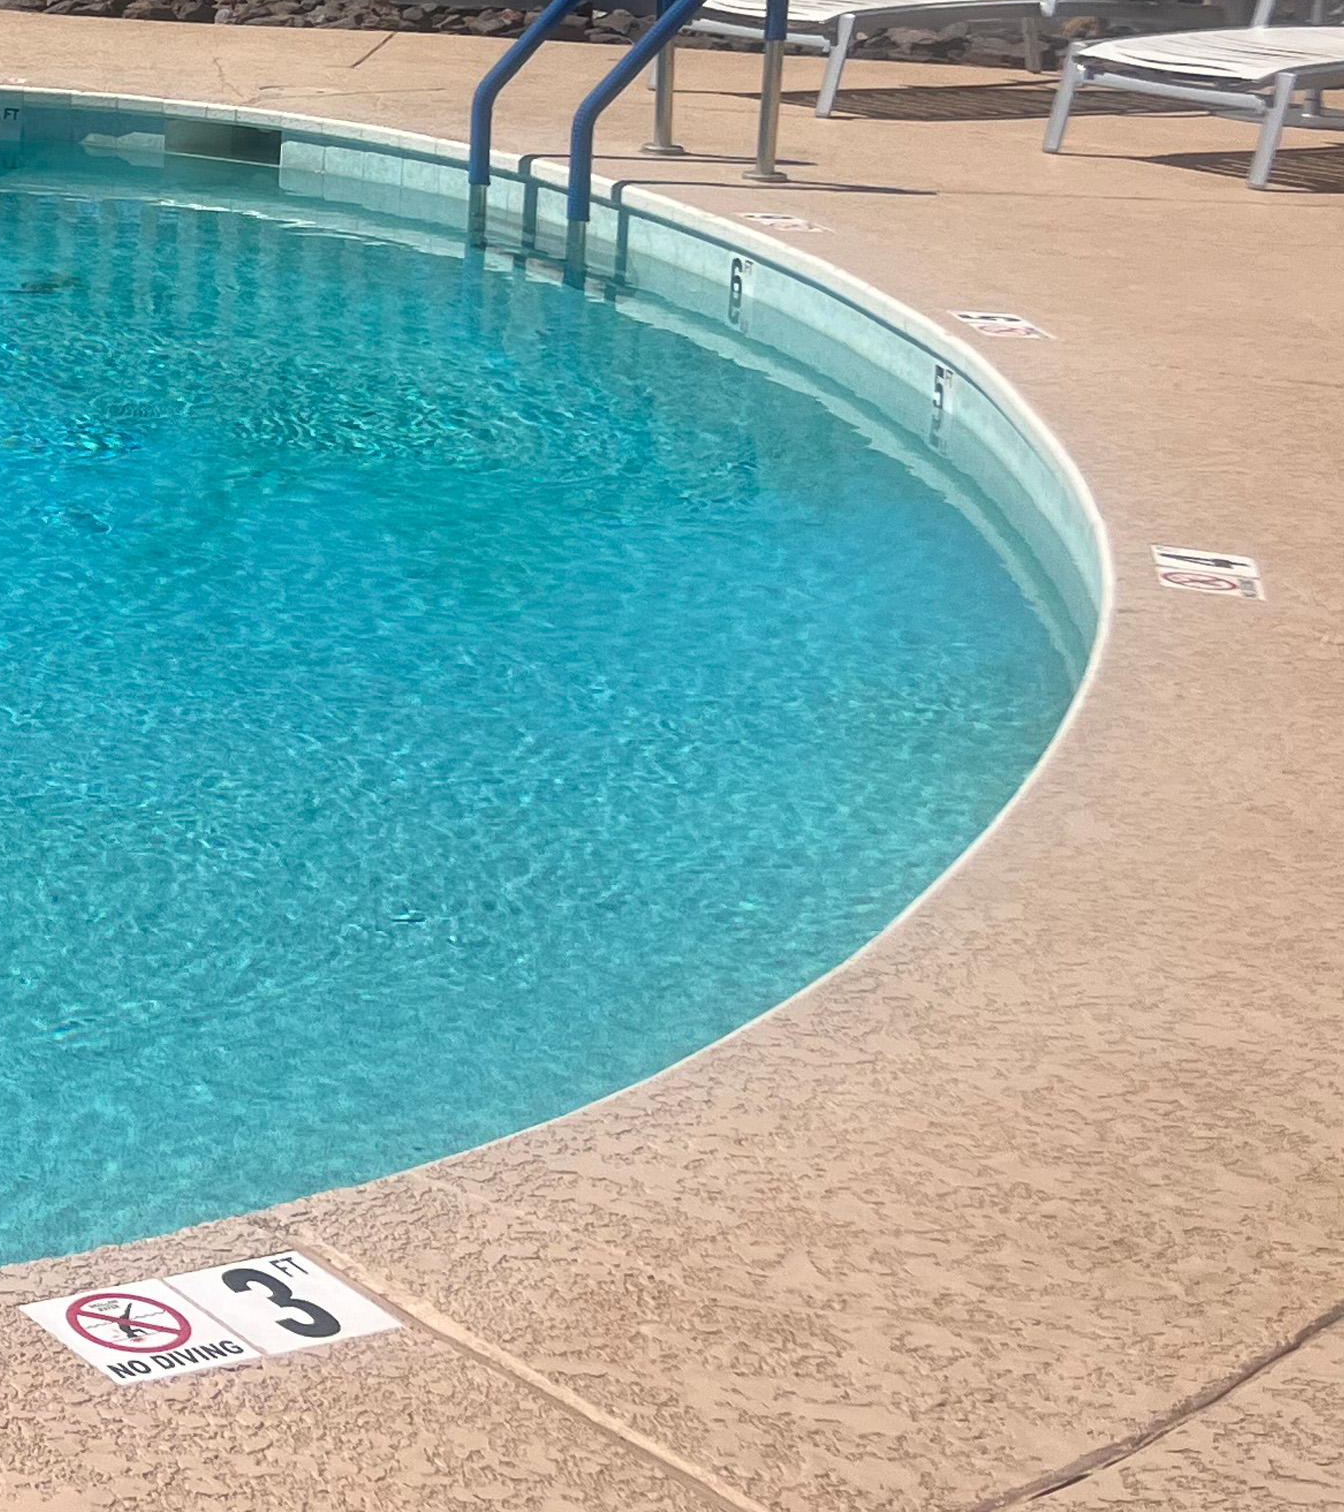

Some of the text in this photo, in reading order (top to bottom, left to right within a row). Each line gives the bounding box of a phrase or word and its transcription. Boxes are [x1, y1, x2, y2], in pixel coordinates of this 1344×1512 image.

[3, 108, 20, 120] FT
[730, 257, 743, 294] 6
[933, 364, 944, 409] 5
[221, 1256, 342, 1338] 3 FT
[106, 1340, 245, 1379] NO DIVING
